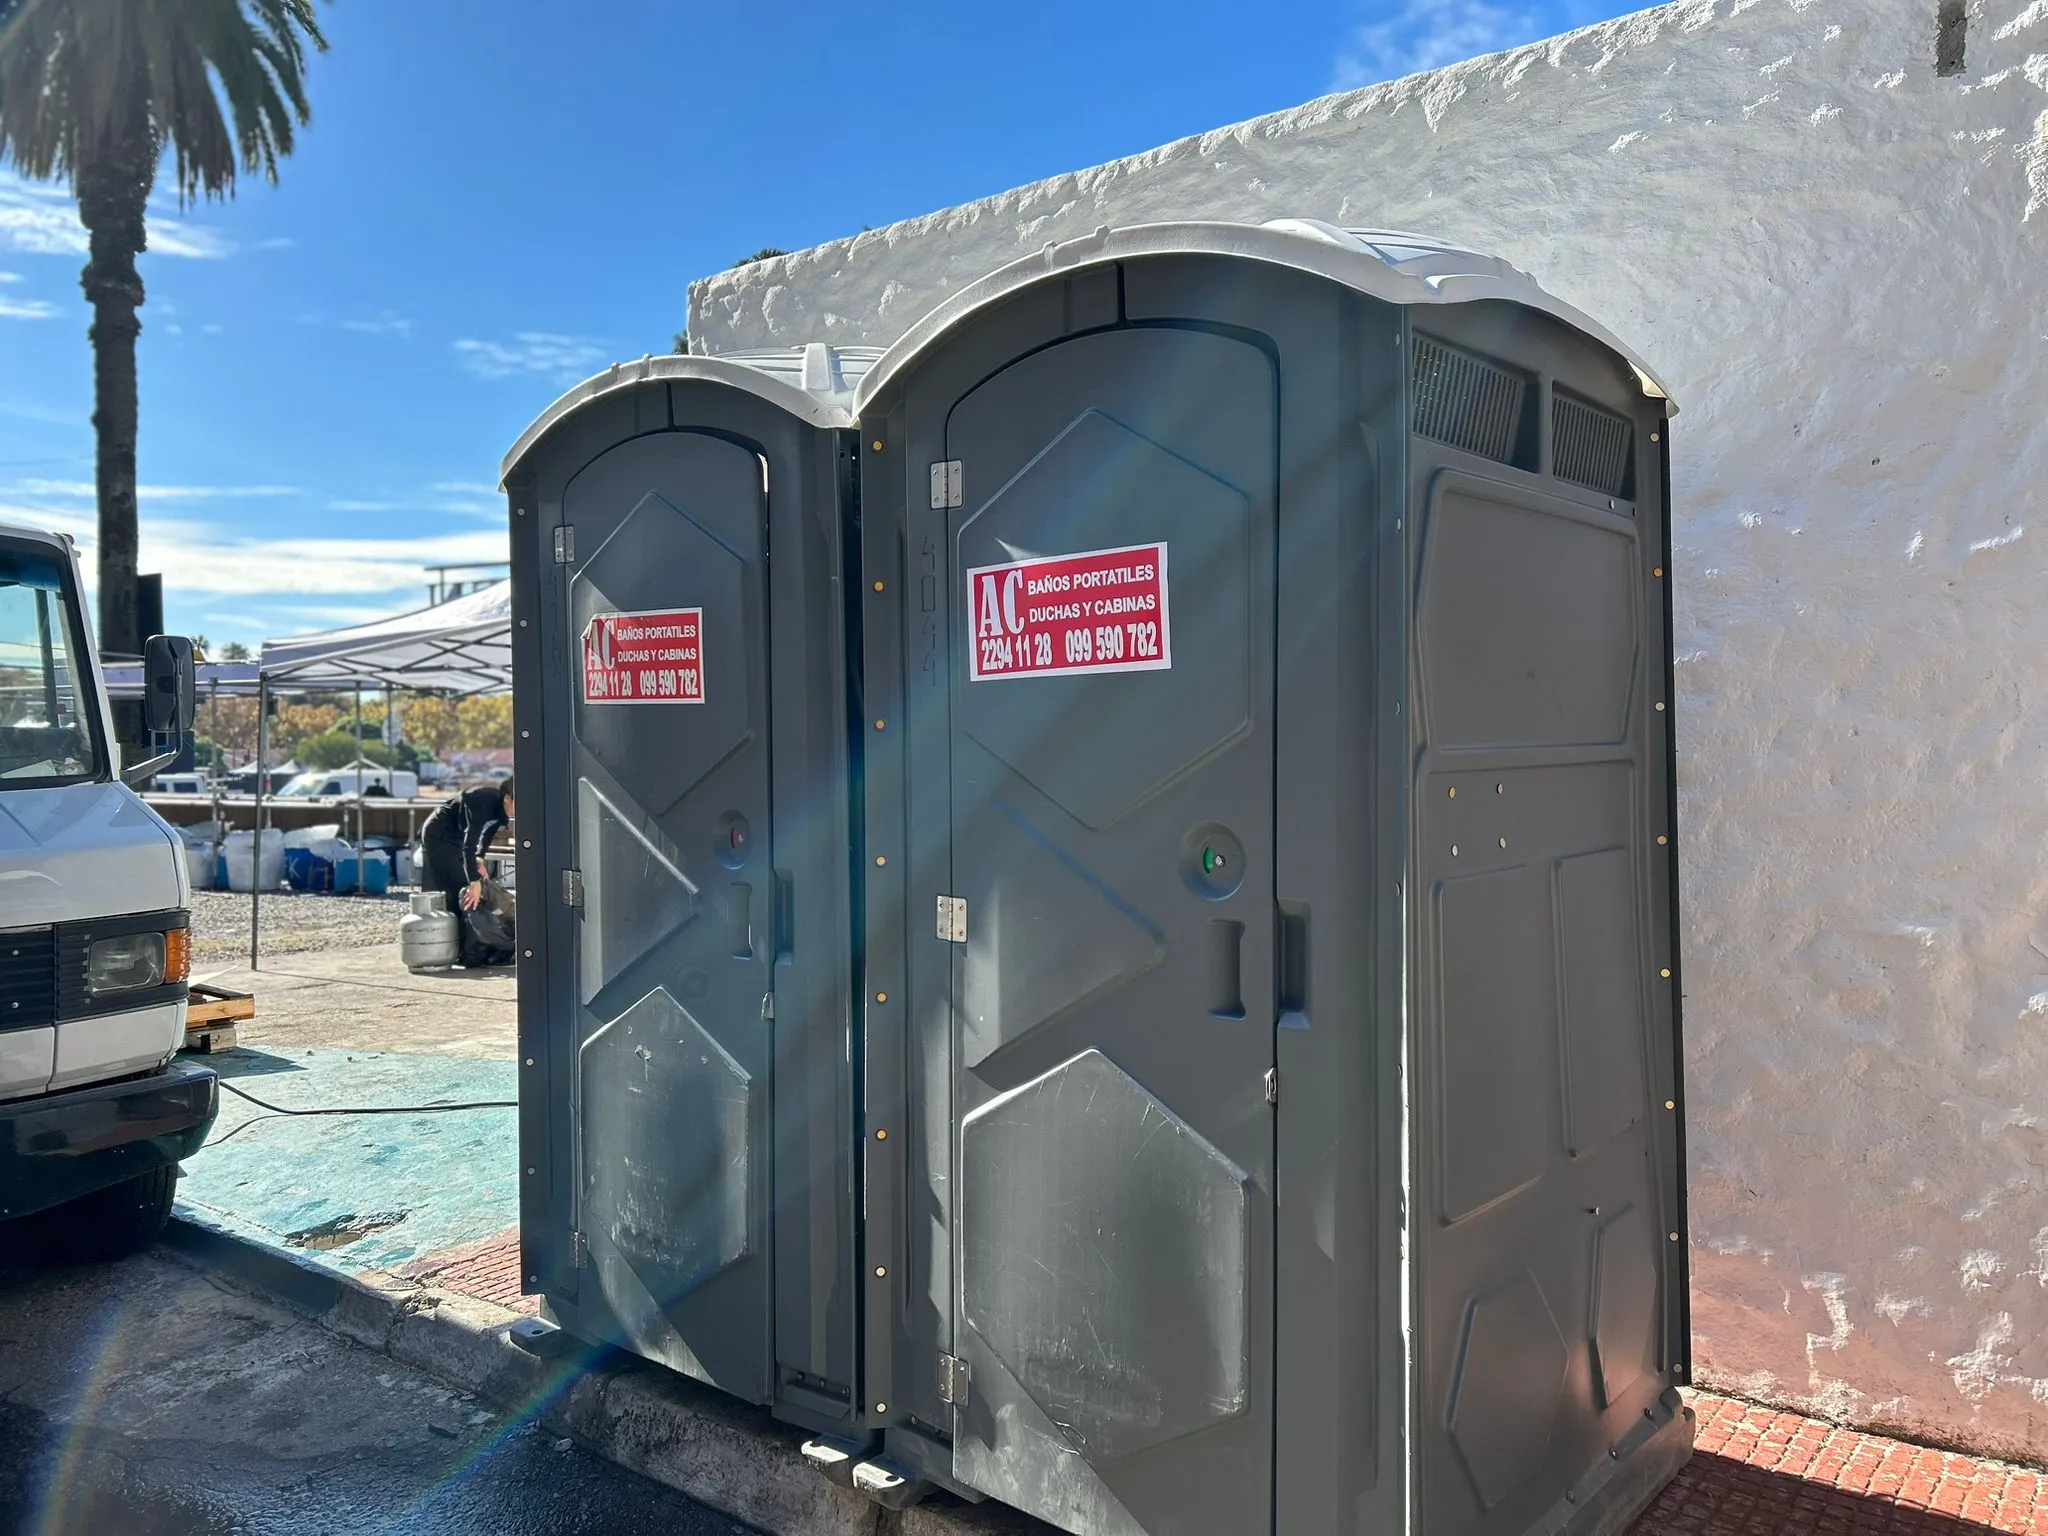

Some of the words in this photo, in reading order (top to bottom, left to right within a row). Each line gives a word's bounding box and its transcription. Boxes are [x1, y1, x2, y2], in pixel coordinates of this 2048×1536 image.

[1028, 575, 1070, 596] BAÑOS
[1073, 564, 1154, 590] PORTATILES
[978, 568, 1025, 638] AC
[1029, 603, 1081, 622] DUCHAS
[1082, 602, 1092, 616] Y
[1094, 594, 1156, 616] CABINAS
[586, 619, 615, 670] AC
[617, 627, 644, 641] BAÑOS
[645, 625, 696, 639] PORTATILES
[981, 636, 1013, 671] 2294
[1015, 634, 1031, 667] 11
[1034, 632, 1053, 666] 28
[1065, 628, 1093, 663] 099
[1096, 624, 1124, 660] 590
[1126, 621, 1158, 657] 782
[618, 650, 650, 663] DUCHAS
[650, 650, 657, 661] Y
[658, 648, 697, 661] CABINAS
[588, 671, 608, 697] 2294
[608, 671, 619, 696] 11
[621, 670, 632, 697] 28
[640, 670, 657, 696] 099
[659, 669, 677, 695] 590
[678, 668, 698, 695] 782
